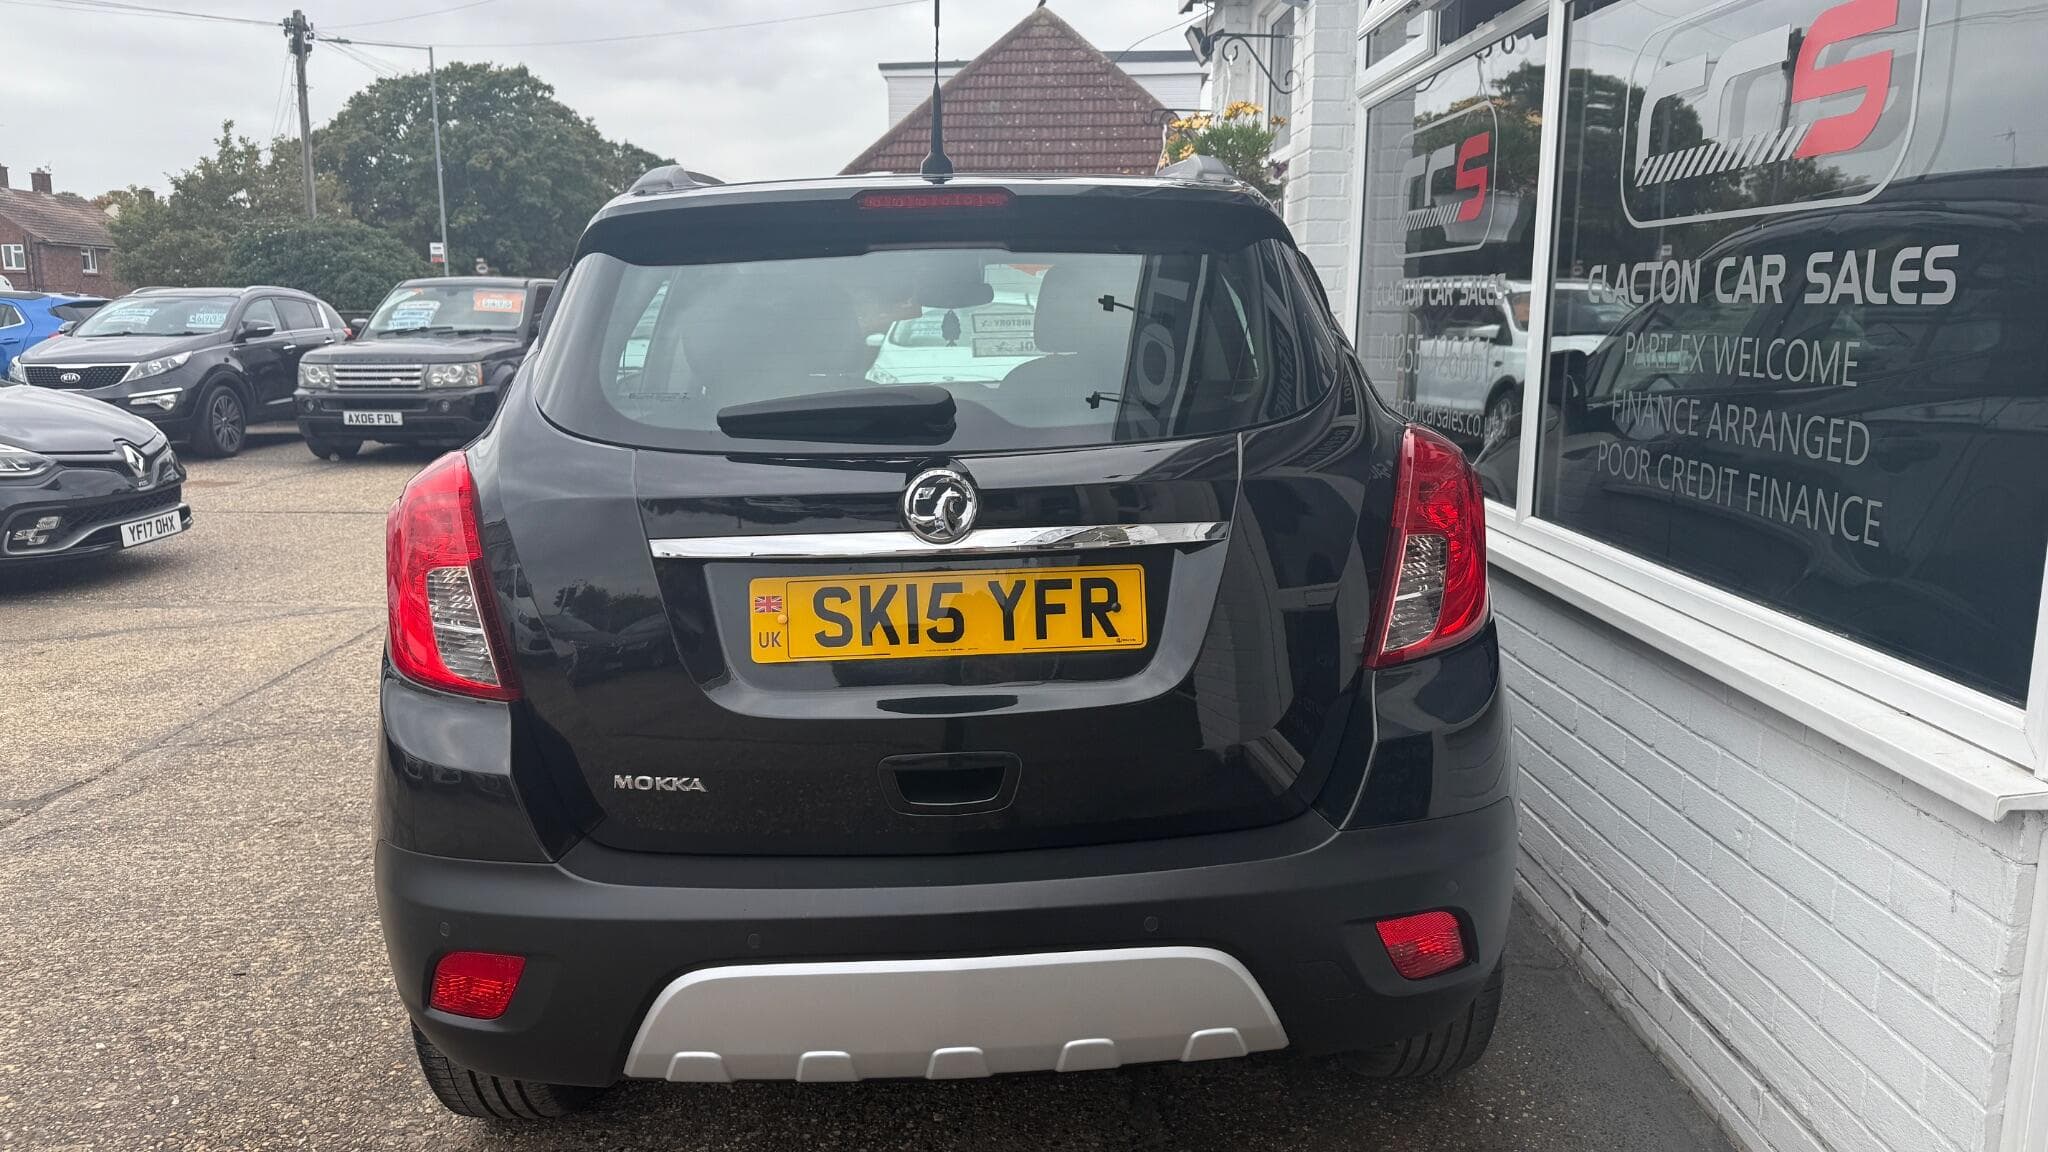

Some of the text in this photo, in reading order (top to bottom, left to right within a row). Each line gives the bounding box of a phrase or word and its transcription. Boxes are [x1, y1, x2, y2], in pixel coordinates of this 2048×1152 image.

[1428, 278, 1454, 306] CAR
[1459, 273, 1506, 306] SALES
[1588, 244, 1960, 306] CLACTON CAR SALES
[1381, 333, 1423, 375] 01255
[1624, 331, 1860, 387] PART EX WELCOME
[348, 413, 398, 424] AX06 FDL
[1612, 390, 1870, 466] FINANCE ARRANGED
[1597, 439, 1883, 547] POOR CREDIT FINANCE
[128, 515, 176, 541] YF17 OHX
[813, 577, 1120, 648] SK15 YFR
[758, 631, 782, 648] UK
[613, 774, 709, 792] MOKKA
